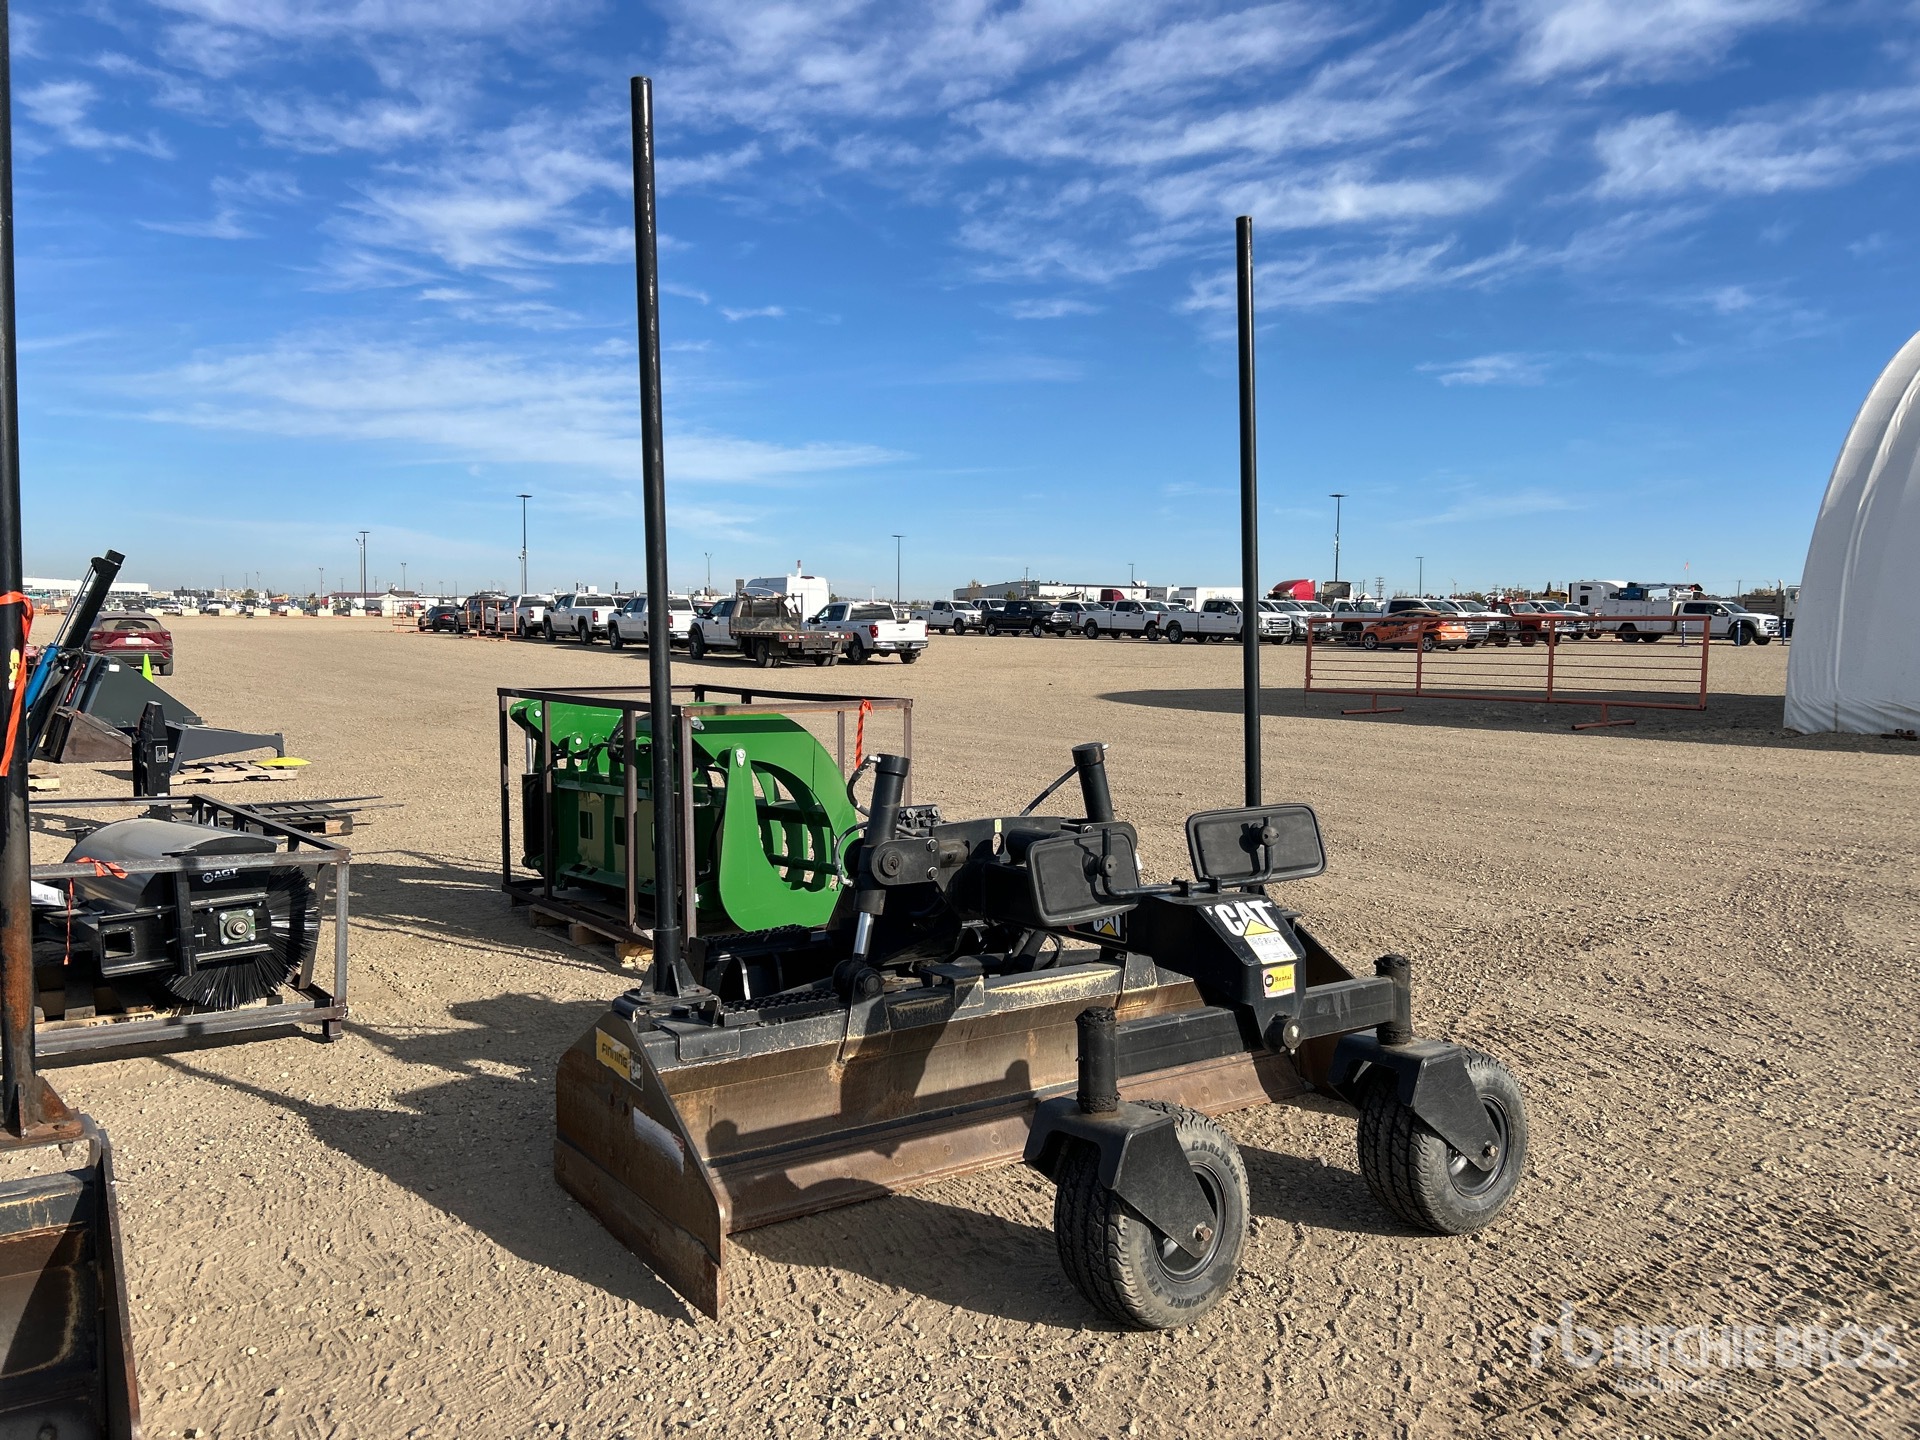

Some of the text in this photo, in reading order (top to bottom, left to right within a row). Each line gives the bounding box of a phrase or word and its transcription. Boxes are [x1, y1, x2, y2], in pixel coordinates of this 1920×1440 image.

[214, 867, 239, 879] AGT
[1214, 900, 1280, 937] CAT
[1191, 1140, 1240, 1184] CARLISLE
